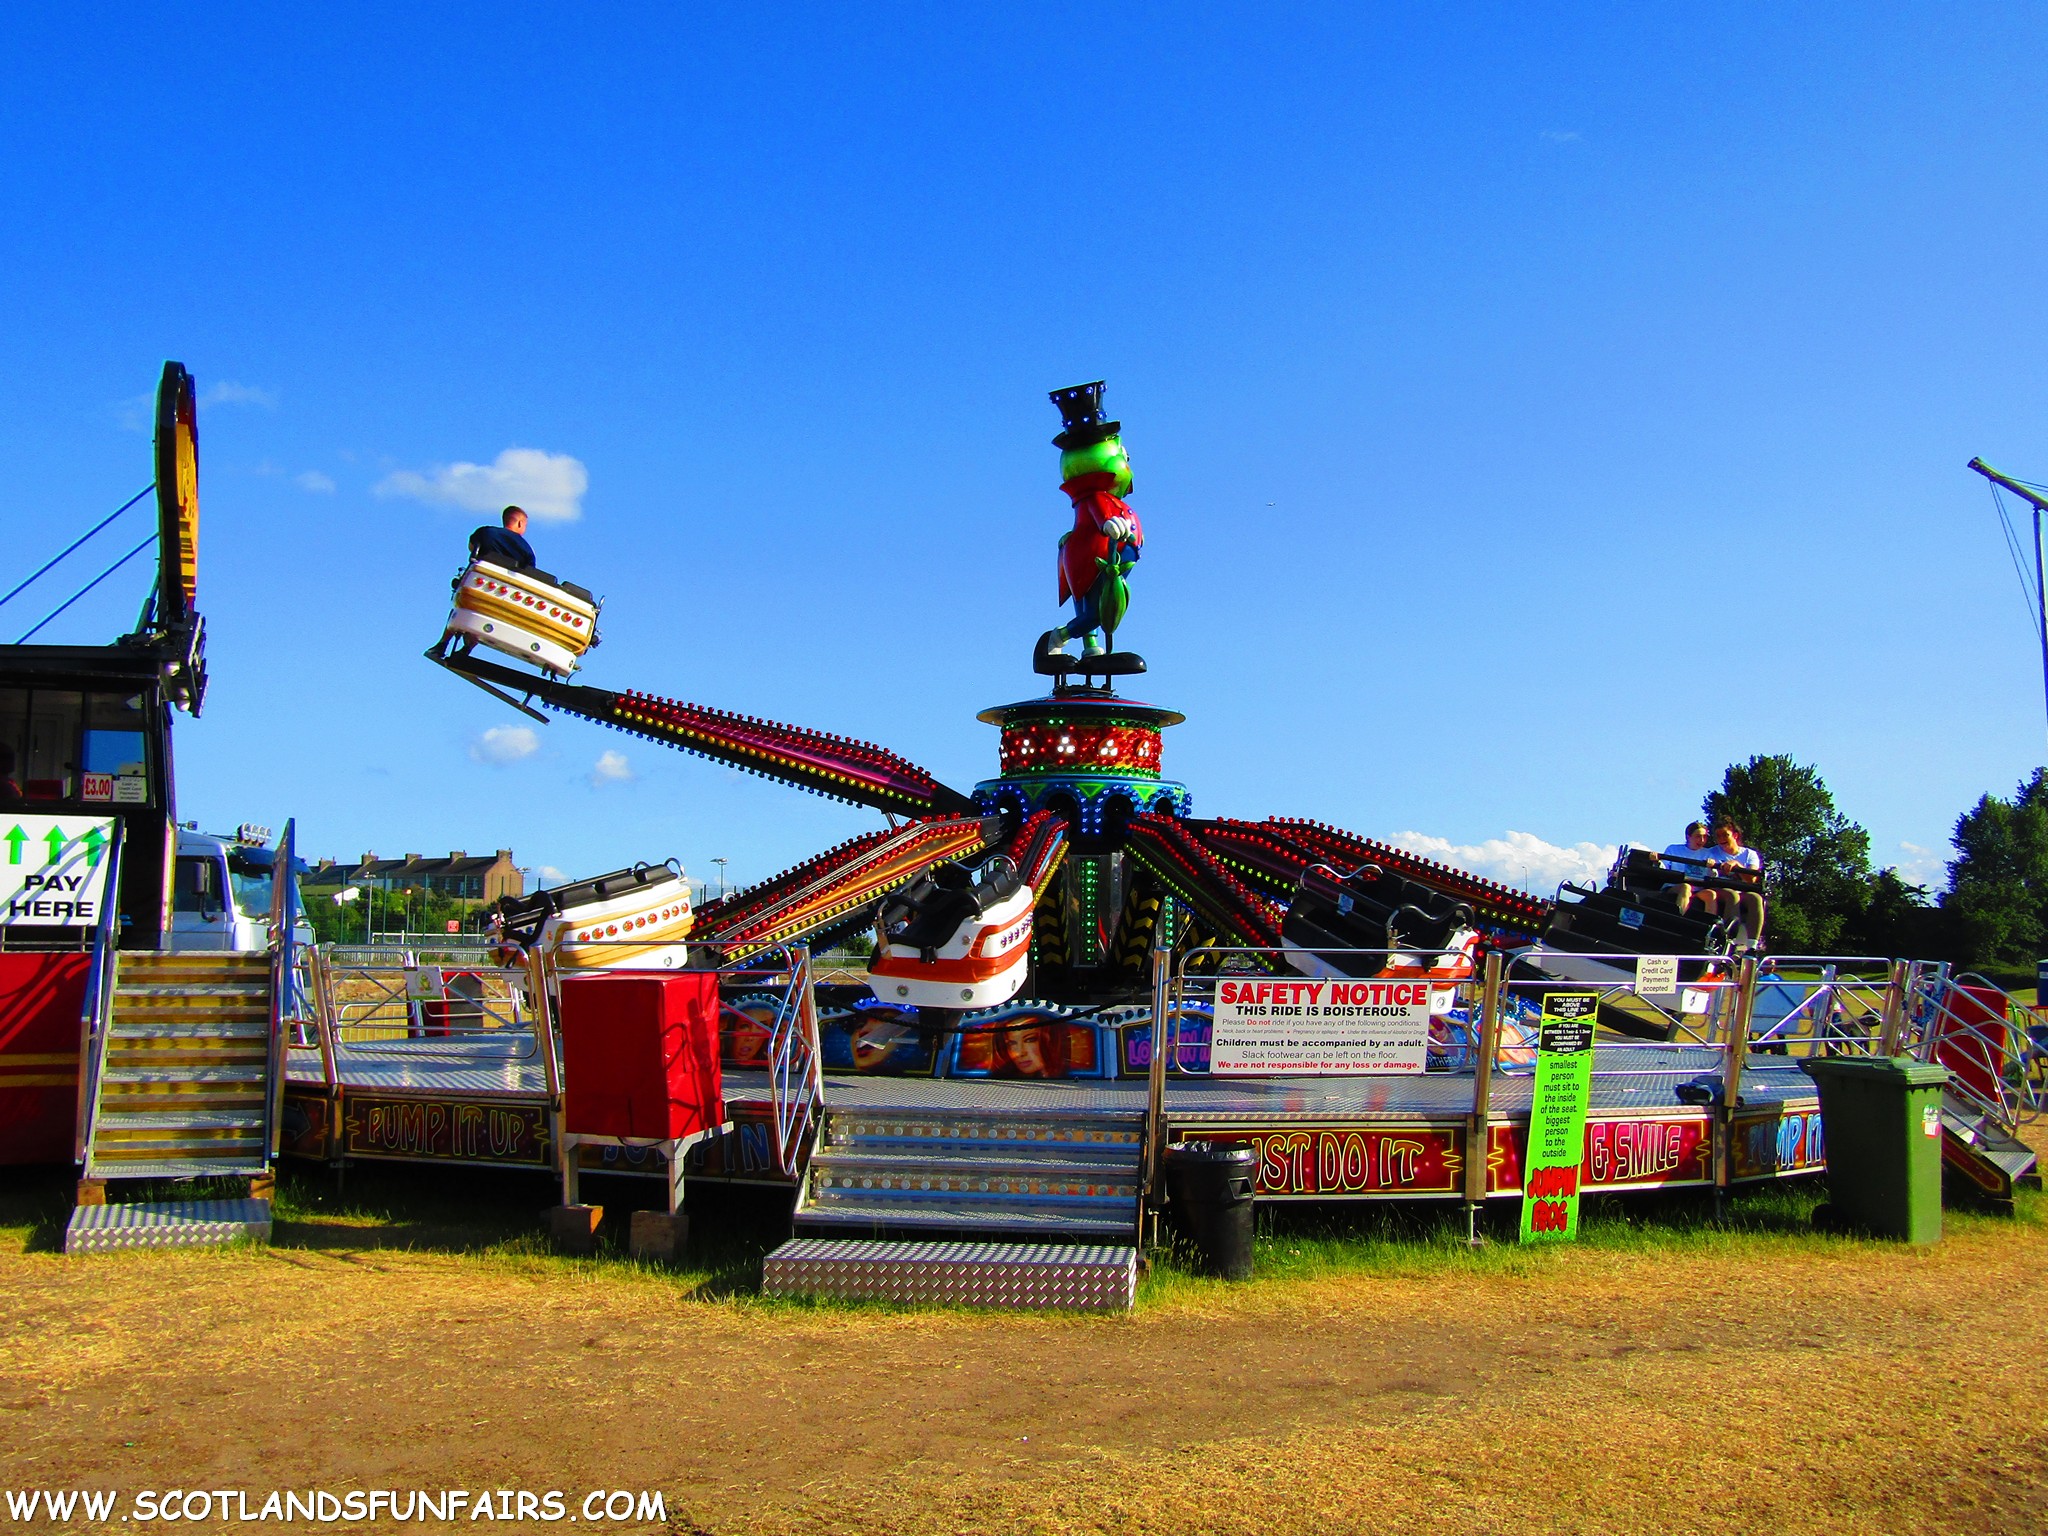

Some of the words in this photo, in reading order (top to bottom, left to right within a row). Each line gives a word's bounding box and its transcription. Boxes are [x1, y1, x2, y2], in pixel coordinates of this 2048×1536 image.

[85, 777, 110, 795] £3.00
[25, 875, 83, 891] PAY
[10, 900, 94, 917] HERE
[1642, 976, 1670, 984] Payments
[1221, 982, 1324, 1005] SAFETY
[1331, 983, 1428, 1006] NOTICE
[1642, 985, 1668, 993] accepted
[1236, 1005, 1267, 1016] THIS
[1271, 1006, 1302, 1016] RIDE
[1306, 1006, 1319, 1016] IS
[1323, 1006, 1411, 1017] BOISTEROUS.
[1222, 1018, 1245, 1026] Please
[1247, 1018, 1257, 1026] Do
[1258, 1018, 1271, 1026] not
[1272, 1018, 1285, 1026] ride
[1286, 1018, 1292, 1026] if
[1292, 1020, 1304, 1028] you
[1305, 1019, 1322, 1027] have
[1323, 1020, 1336, 1028] any
[1337, 1019, 1344, 1027] of
[1345, 1019, 1356, 1027] the
[1357, 1019, 1386, 1029] following
[1387, 1019, 1421, 1028] conditions:
[1216, 1039, 1257, 1047] Children
[1260, 1039, 1285, 1047] must
[1287, 1039, 1299, 1047] be
[1302, 1039, 1367, 1048] accompanied
[1369, 1039, 1381, 1048] by
[1397, 1039, 1424, 1047] adult.
[1242, 1050, 1265, 1059] Slack
[1267, 1050, 1304, 1059] footwear
[1305, 1051, 1320, 1059] can
[1323, 1051, 1333, 1059] be
[1335, 1051, 1349, 1059] left
[1363, 1051, 1377, 1059] the
[1378, 1051, 1398, 1059] floor.
[1267, 1061, 1318, 1070] responsible
[1334, 1062, 1350, 1070] any
[1383, 1061, 1420, 1070] damage.
[1549, 1060, 1578, 1070] smallest
[1551, 1072, 1575, 1082] person
[1543, 1084, 1561, 1092] must
[1562, 1082, 1571, 1091] sit
[1572, 1083, 1580, 1091] to
[1545, 1094, 1556, 1102] the
[1557, 1093, 1577, 1102] inside
[1540, 1104, 1548, 1114] of
[1549, 1104, 1560, 1113] the
[1545, 1115, 1570, 1126] biggest
[368, 1103, 446, 1155] PUMP
[453, 1105, 483, 1156] IT
[490, 1110, 525, 1156] UP
[1545, 1127, 1569, 1137] person
[1545, 1137, 1553, 1146] to
[1554, 1137, 1566, 1146] the
[1542, 1148, 1567, 1158] outside
[1590, 1123, 1609, 1181] &
[1613, 1122, 1682, 1180] SMILE
[1319, 1132, 1369, 1193] DO
[1379, 1137, 1425, 1187] IT
[1527, 1164, 1579, 1199] JUMPIN
[1531, 1199, 1568, 1233] FROG
